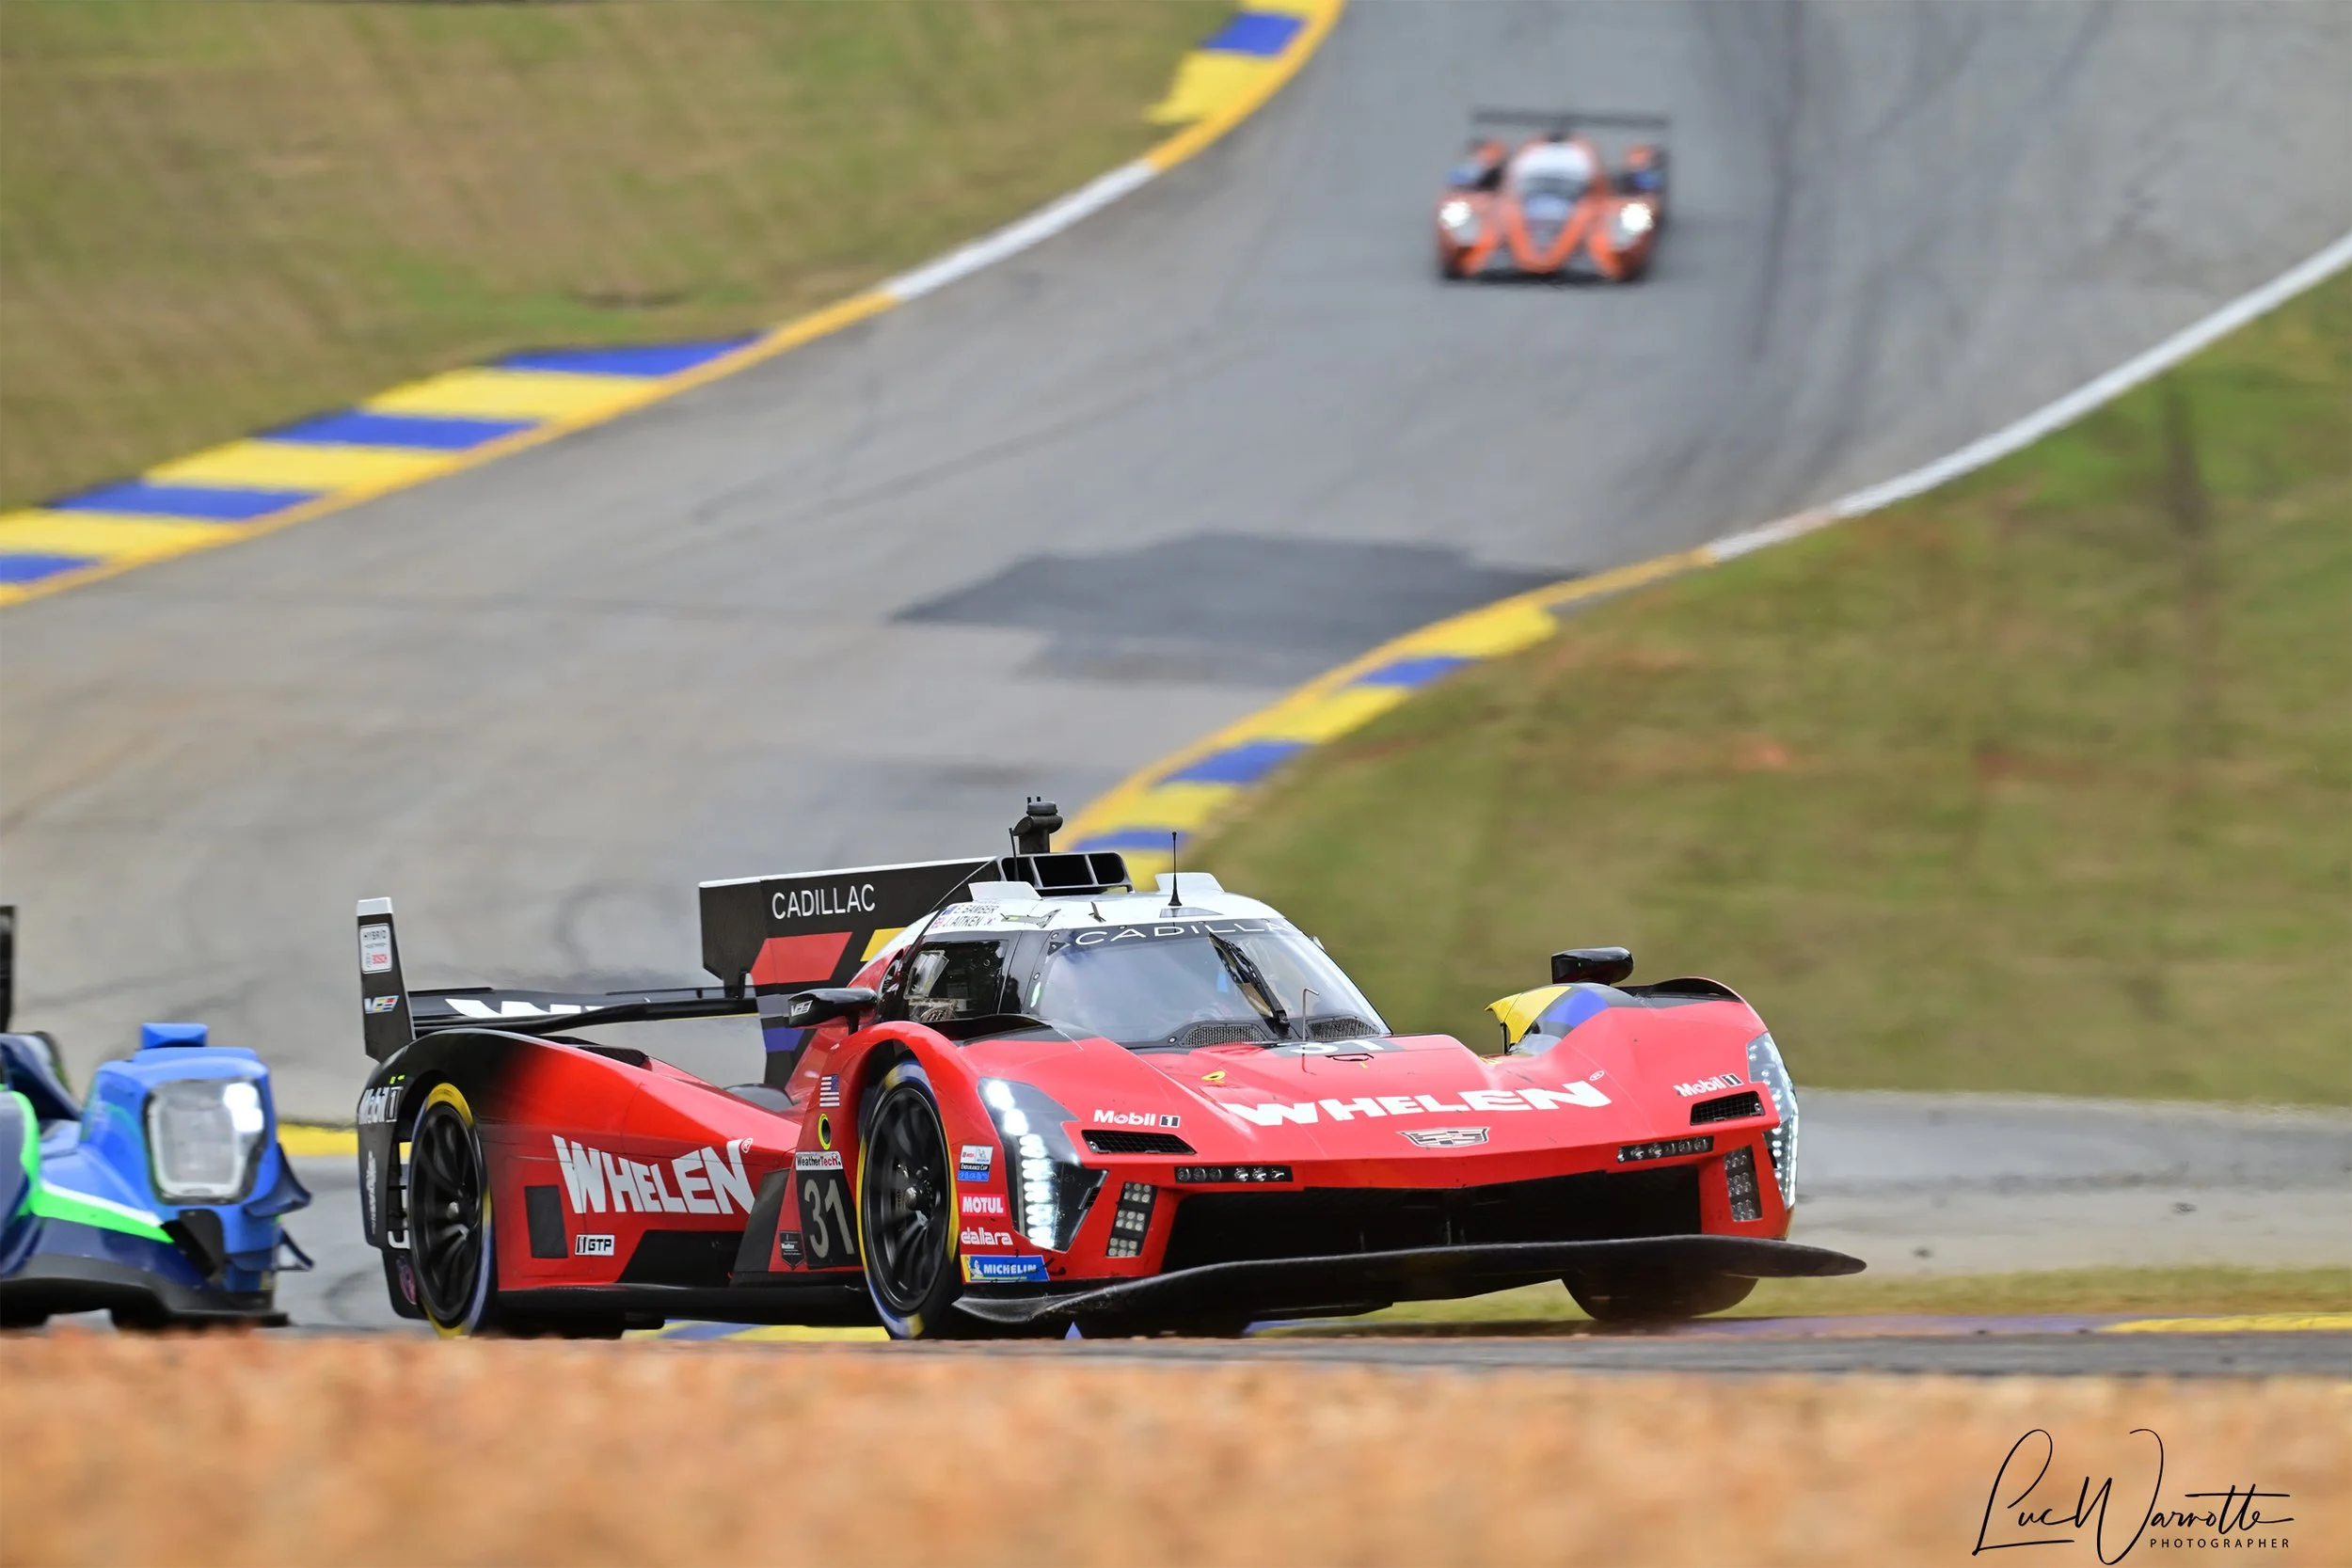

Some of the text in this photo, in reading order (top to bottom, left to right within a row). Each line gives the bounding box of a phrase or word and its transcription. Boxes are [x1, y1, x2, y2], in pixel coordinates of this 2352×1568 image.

[771, 883, 876, 920] CADILLAC
[1673, 1076, 1726, 1097] Mobil
[1225, 1081, 1612, 1126] WHELEN
[1093, 1109, 1156, 1126] Mobil
[797, 1155, 838, 1167] WeatherTech
[551, 1133, 755, 1214] WHELEN
[962, 1196, 1004, 1213] MOTUL
[804, 1179, 855, 1259] 31
[588, 1238, 612, 1251] GTP
[961, 1227, 1013, 1245] dallara
[983, 1263, 1037, 1275] MICHELIN
